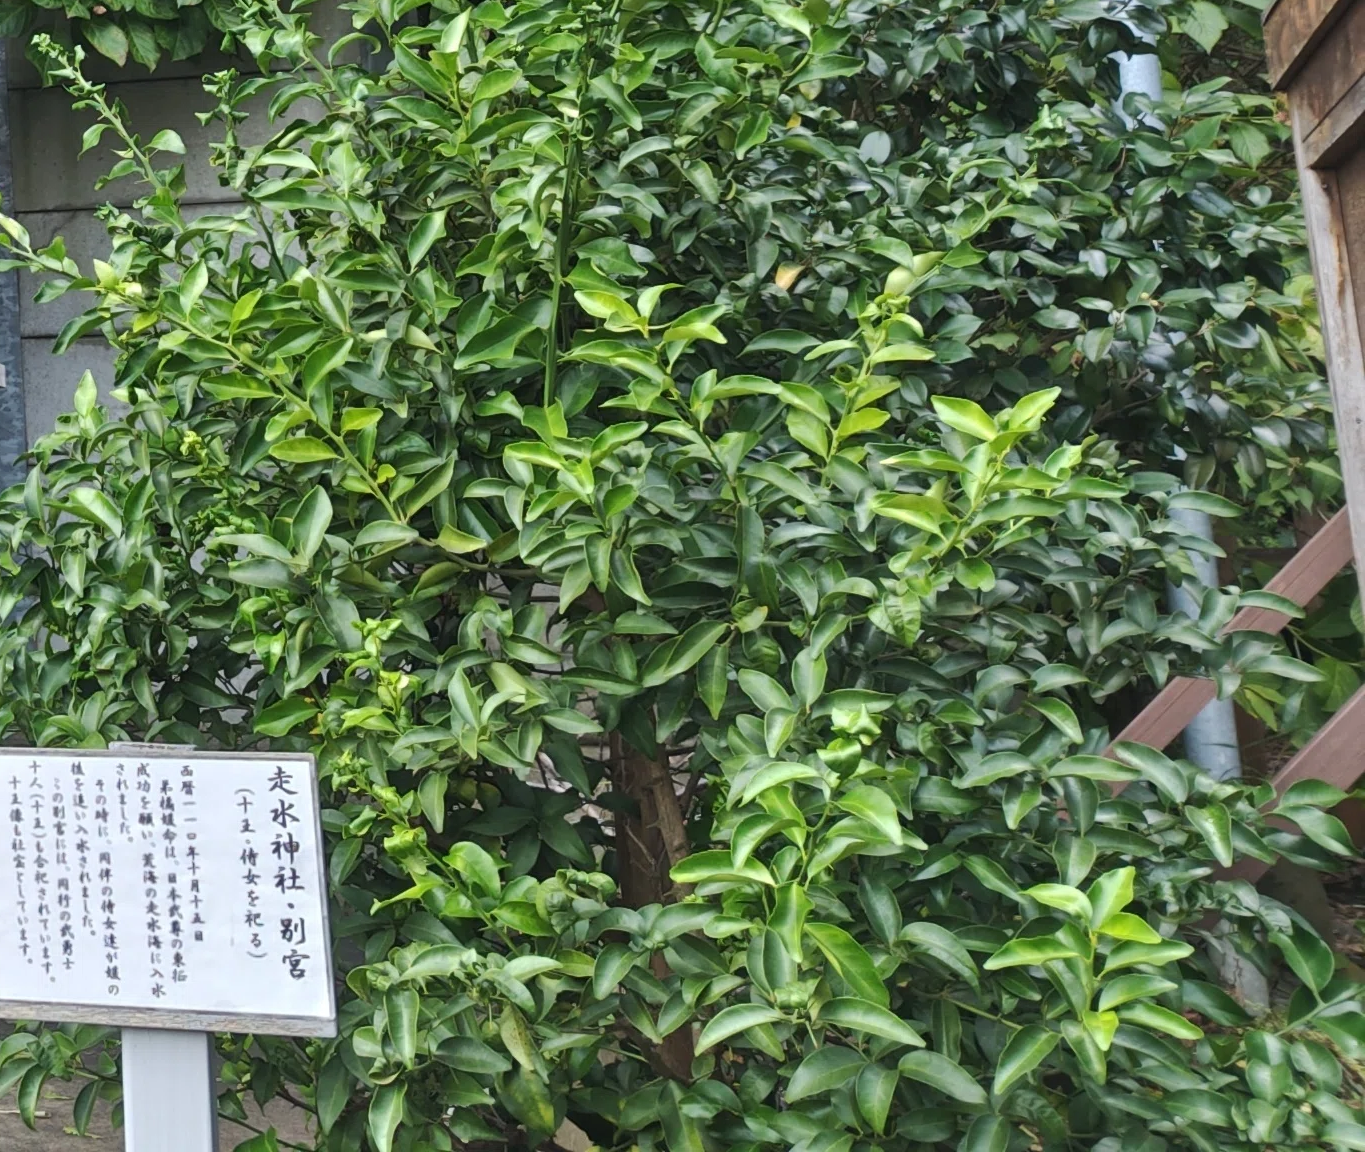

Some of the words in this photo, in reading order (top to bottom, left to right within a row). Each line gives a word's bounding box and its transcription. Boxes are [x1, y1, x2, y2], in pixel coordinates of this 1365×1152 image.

[267, 766, 310, 980] 走水神社・別宮
